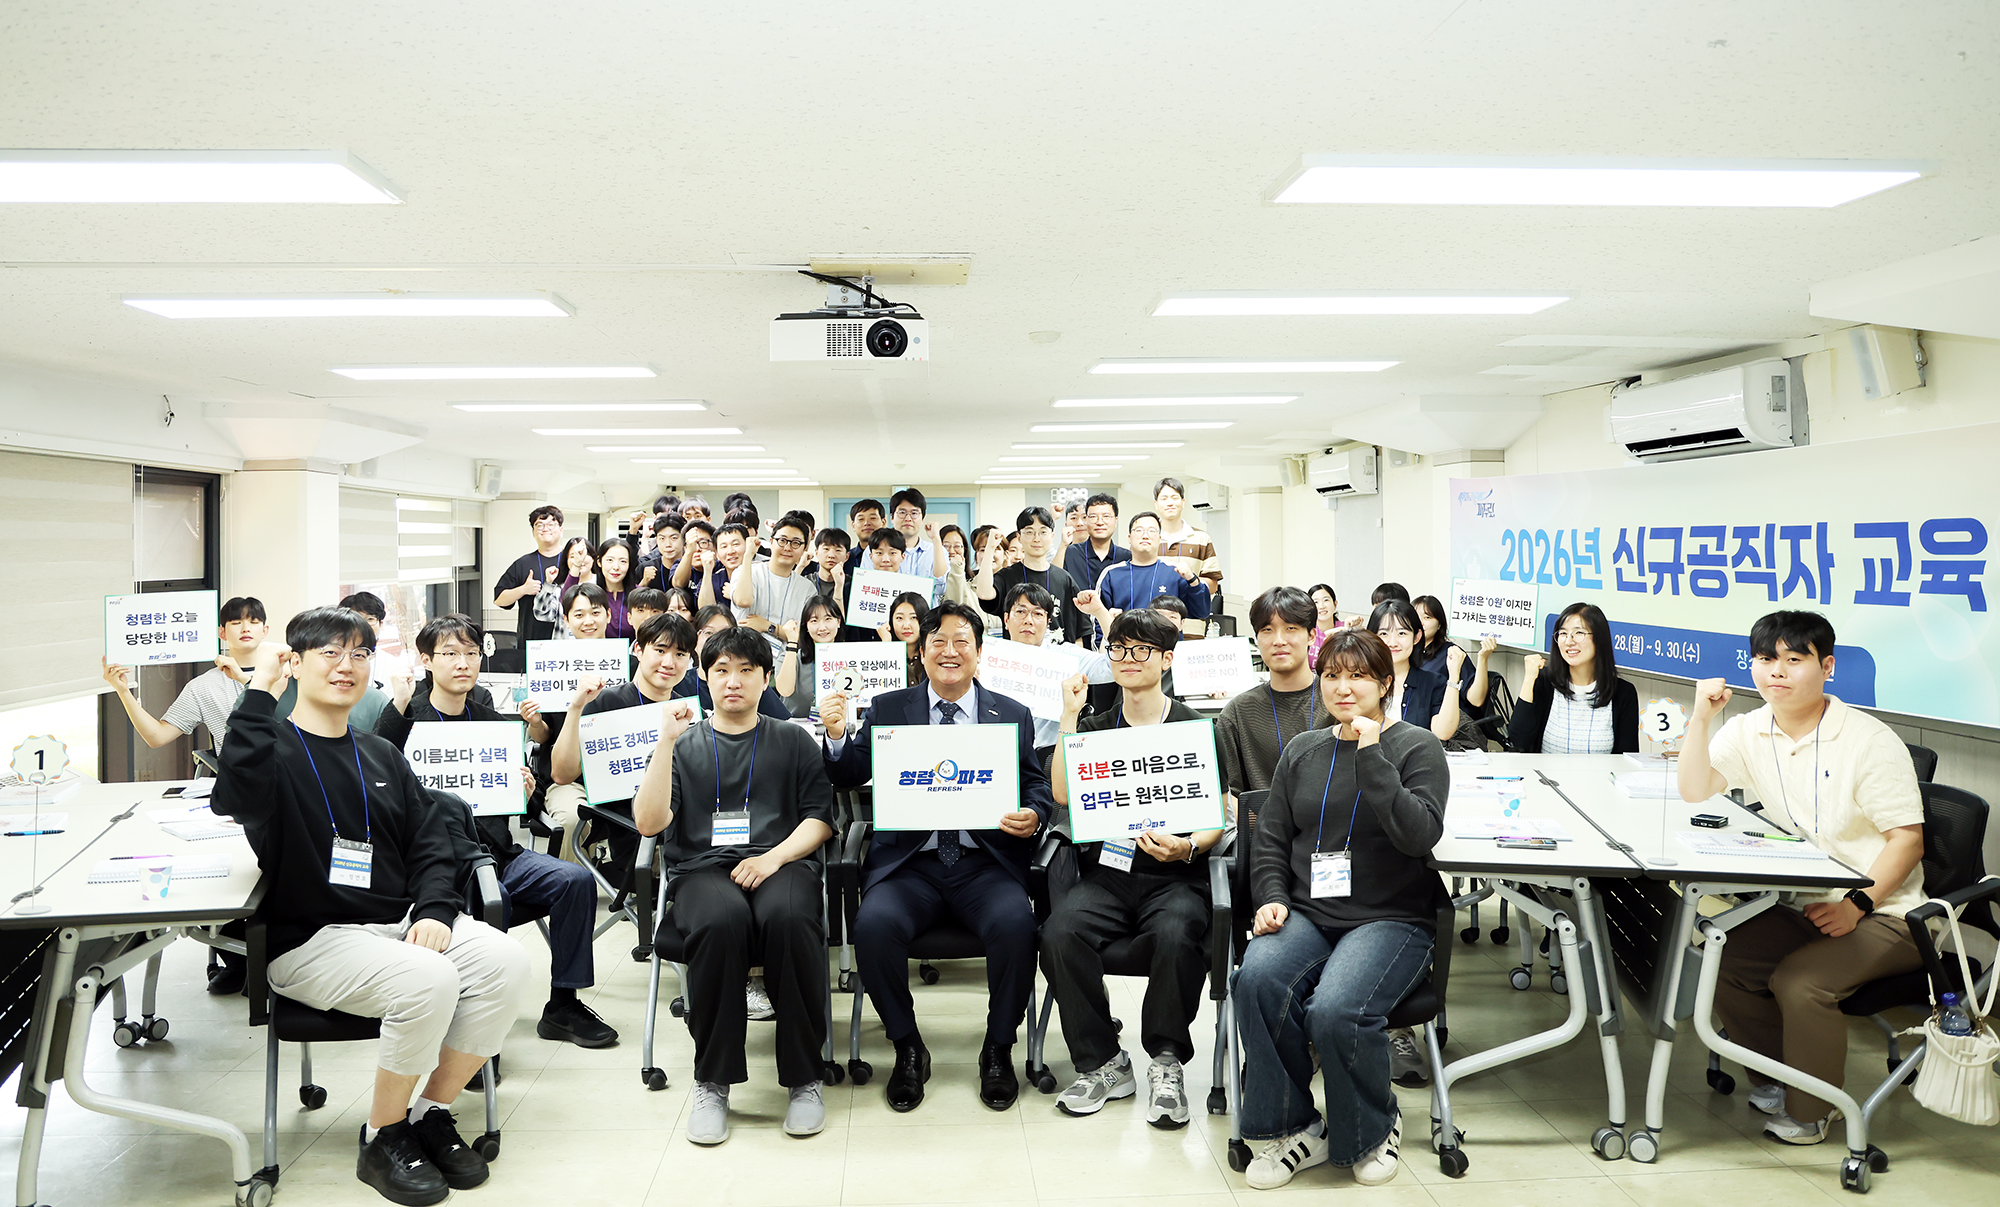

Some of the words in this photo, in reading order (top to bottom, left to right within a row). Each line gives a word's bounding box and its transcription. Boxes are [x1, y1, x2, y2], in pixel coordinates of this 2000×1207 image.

[1499, 526, 1603, 590] 2026년
[1612, 521, 1835, 604] 신규공직자
[1853, 517, 1989, 612] 교육
[861, 585, 889, 598] 부패는
[858, 600, 887, 613] 청렴은
[1460, 594, 1484, 606] 청렴은
[126, 612, 167, 626] 청렴한
[171, 611, 198, 623] 오늘
[1452, 611, 1460, 620] 그
[1462, 612, 1487, 623] 가치는
[1489, 614, 1534, 628] 영원합니다.
[126, 632, 167, 646] 당당한
[172, 630, 198, 642] 내일
[487, 640, 491, 650] 6
[1187, 654, 1214, 664] 청렴은
[1218, 653, 1236, 662] ON!
[1614, 634, 1644, 656] 28.(월)
[1666, 641, 1700, 664] 30.(수)
[1736, 649, 1752, 670] 장
[535, 660, 569, 672] 파주가
[573, 659, 595, 671] 웃는
[598, 659, 621, 670] 순간
[988, 656, 1032, 675] 연고주의
[1220, 667, 1238, 676] NO!
[530, 680, 563, 692] 청렴이
[844, 676, 853, 690] 2
[991, 675, 1037, 696] 청렴조직
[1657, 713, 1670, 731] 3
[585, 736, 622, 755] 평화도
[624, 729, 658, 748] 경제도
[34, 749, 44, 770] 1
[413, 748, 474, 764] 이름보다
[479, 747, 507, 762] 실력
[609, 757, 645, 775] 청렴도
[1078, 759, 1127, 781] 친분은
[1132, 752, 1205, 774] 마음으로,
[480, 773, 508, 788] 원칙
[957, 769, 993, 784] 파주
[1080, 790, 1130, 811] 업무는
[1135, 782, 1209, 805] 원칙으로.
